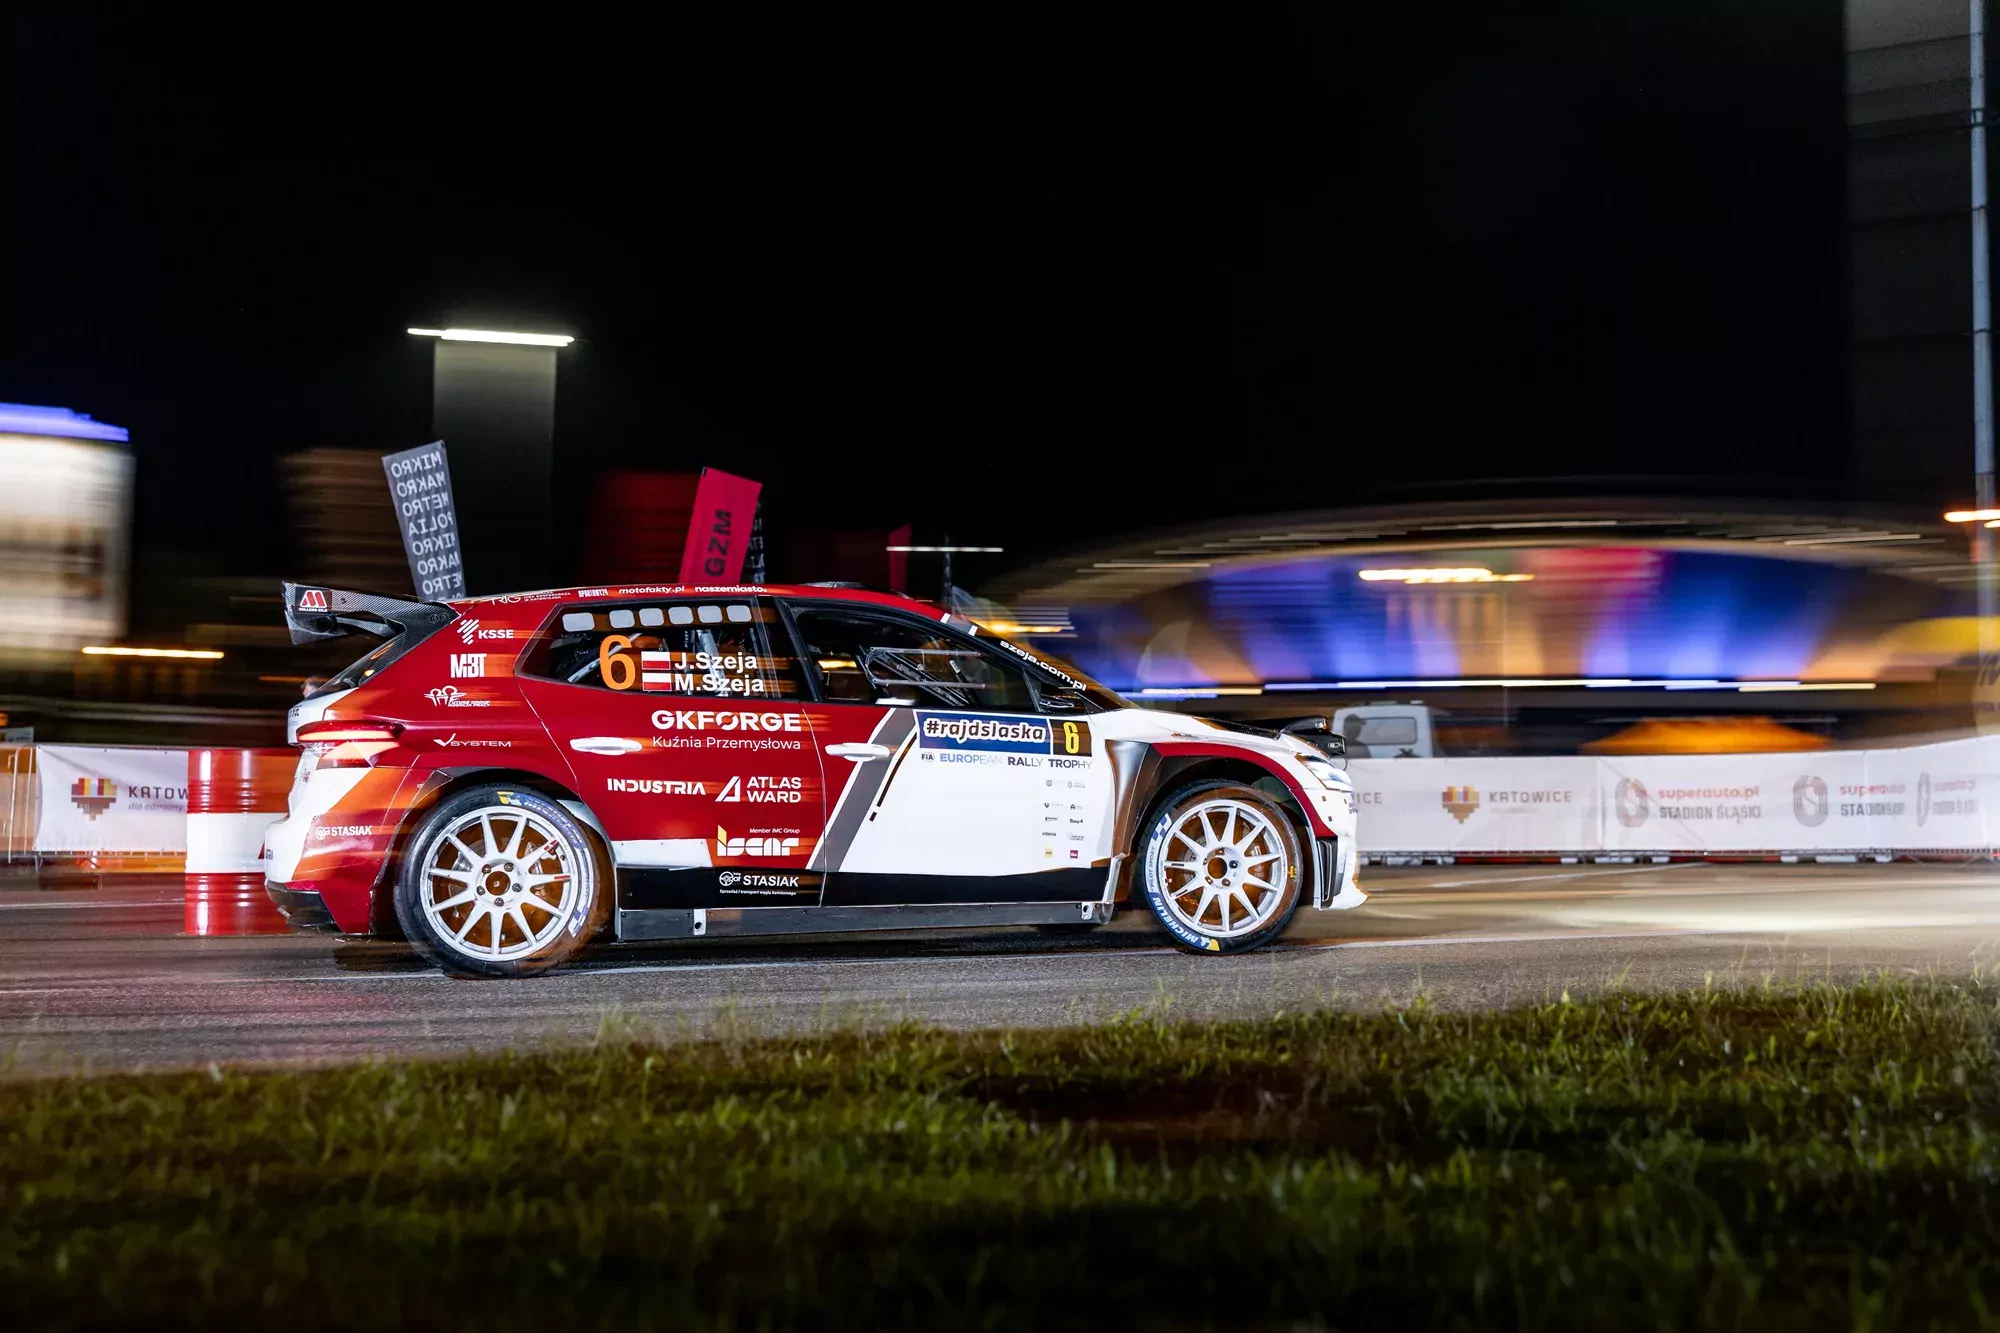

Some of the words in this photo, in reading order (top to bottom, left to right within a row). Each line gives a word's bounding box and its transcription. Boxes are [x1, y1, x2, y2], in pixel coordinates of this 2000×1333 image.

[705, 509, 732, 577] GZM
[618, 586, 685, 594] motofakty.pl
[478, 629, 514, 639] KSSE
[600, 634, 636, 690] 6
[674, 652, 758, 674] J.Szeja
[1000, 640, 1087, 692] szeja.com.pl
[674, 674, 765, 696] M.Szeja
[651, 710, 801, 732] GKFORGE
[925, 719, 1044, 741] #rajdslaska
[1063, 722, 1080, 754] 6
[652, 736, 701, 748] Kuźnia
[706, 736, 801, 752] Przemysłowa
[940, 753, 1003, 765] EUROPEAN
[1007, 756, 1044, 767] RALLY
[1048, 758, 1092, 769] TROPHY
[607, 778, 706, 795] INDUSTRIA
[746, 776, 802, 788] ATLAS
[746, 791, 802, 803] WARD
[1489, 790, 1572, 803] KATOWICE
[1658, 785, 1760, 801] superauto.pl
[1660, 806, 1712, 819] STADION
[332, 826, 372, 836] STASIAK
[743, 875, 799, 887] STASIAK
[1152, 897, 1198, 944] MICHELIN
